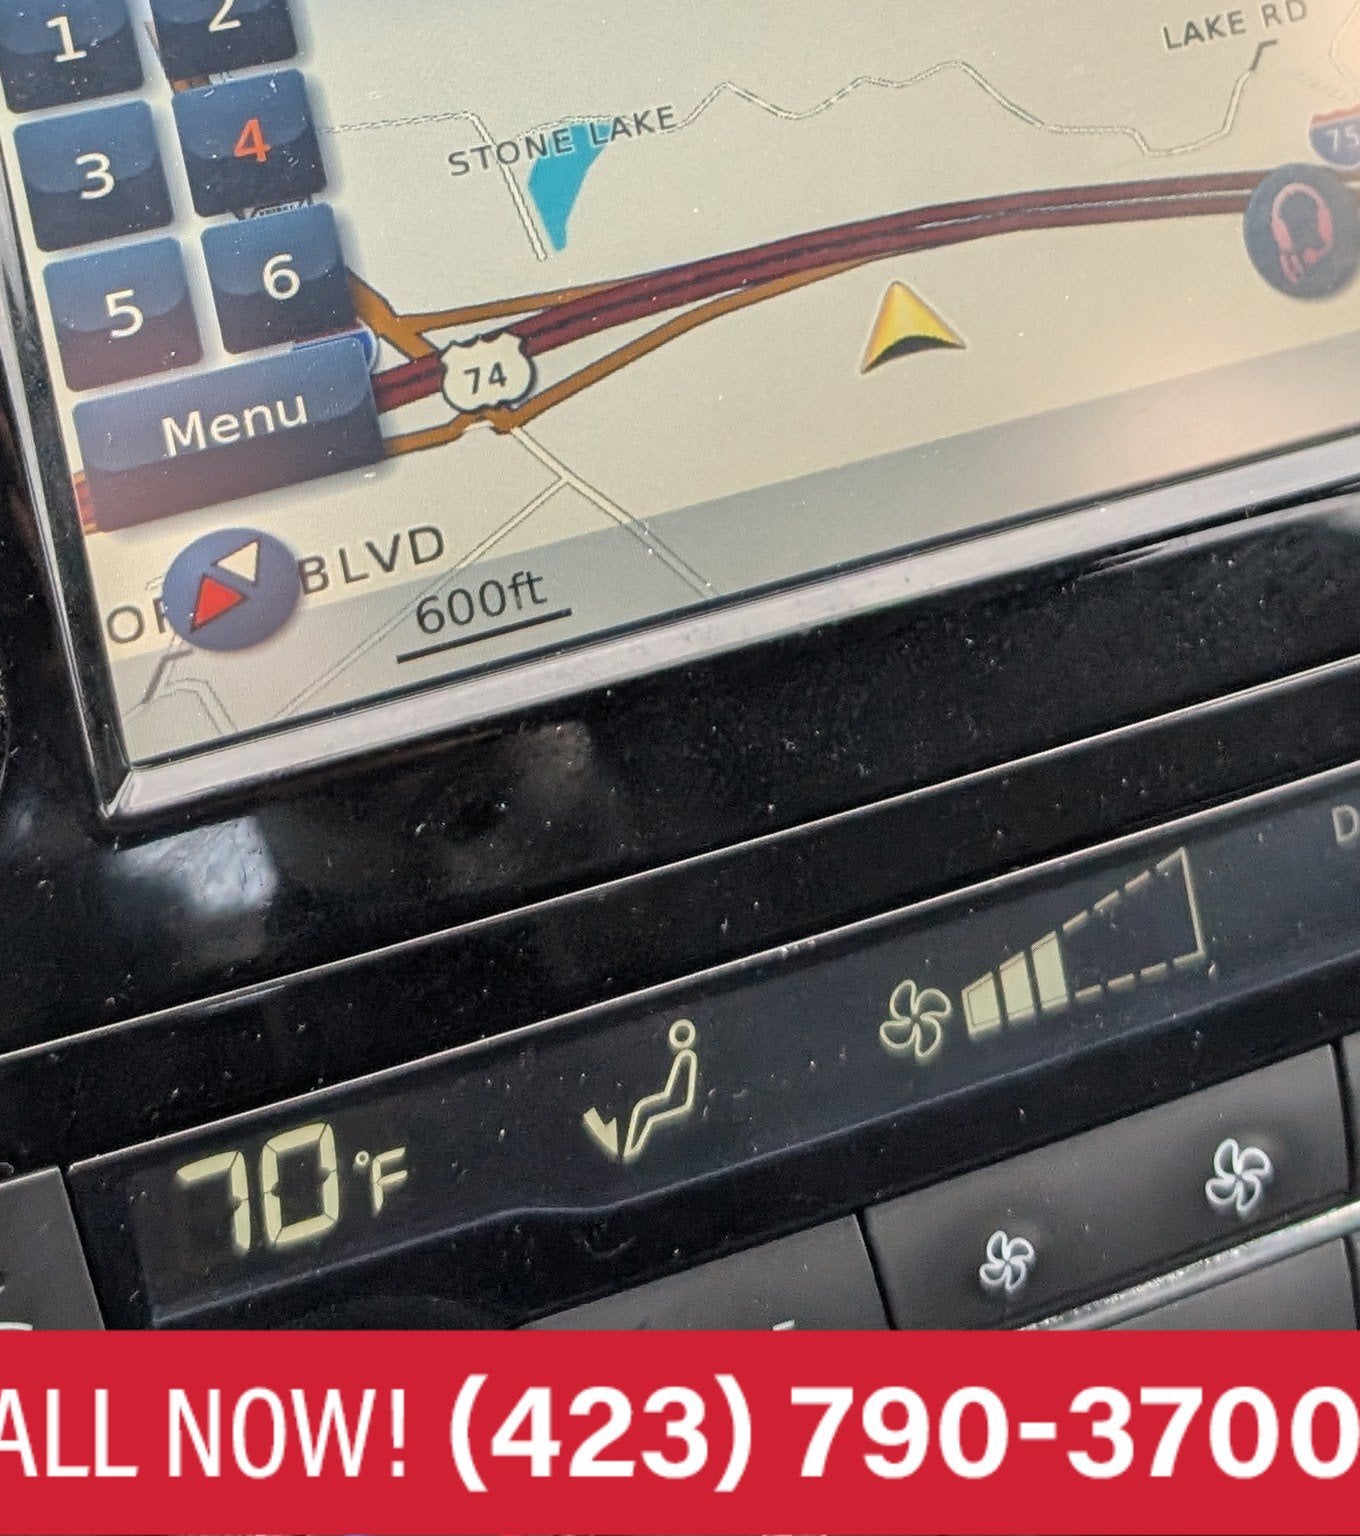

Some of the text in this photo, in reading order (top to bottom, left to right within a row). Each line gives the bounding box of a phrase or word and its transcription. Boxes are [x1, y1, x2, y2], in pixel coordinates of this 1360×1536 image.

[46, 14, 86, 63] 1
[1162, 10, 1246, 51] LAKE
[233, 118, 272, 163] 4
[447, 105, 676, 178] STONE LAKE
[1326, 123, 1360, 150] 75
[76, 153, 114, 200] 3
[262, 255, 300, 300] 6
[104, 290, 143, 338] 5
[464, 361, 508, 396] 74
[162, 394, 307, 458] Menu
[297, 526, 444, 594] BLVD
[417, 570, 547, 634] 600ft
